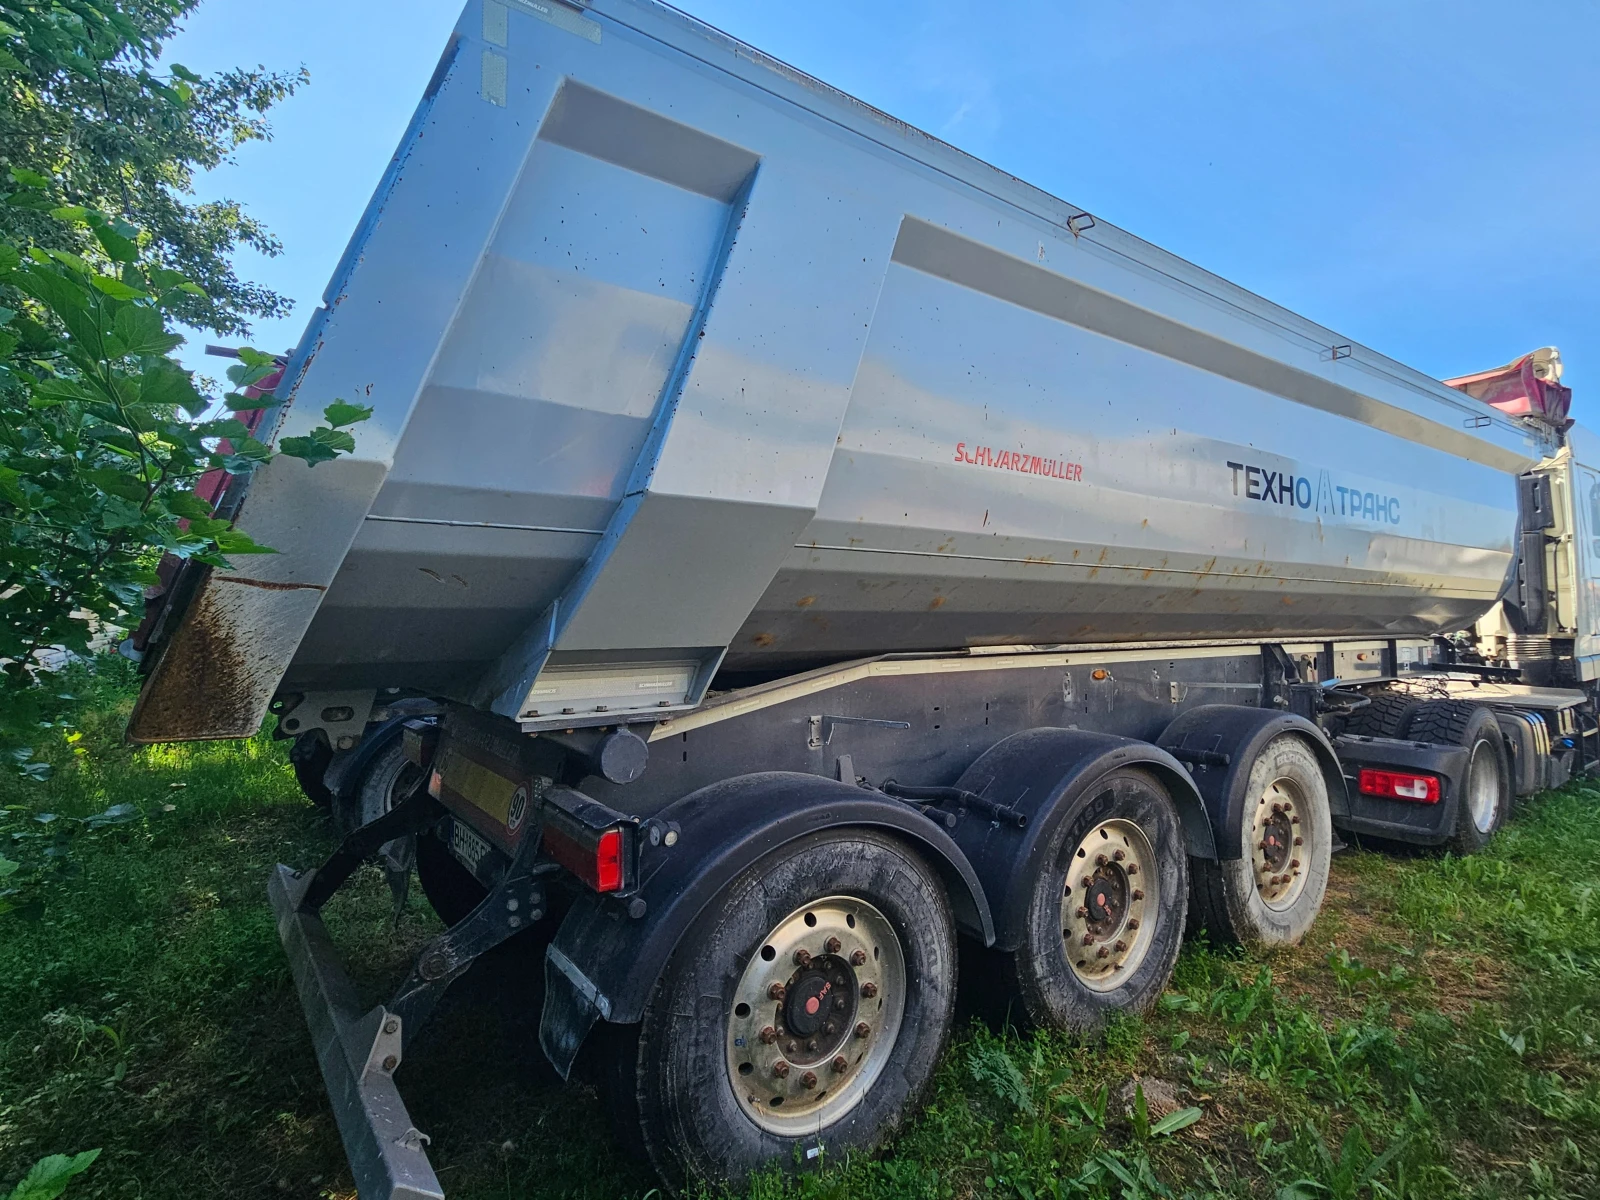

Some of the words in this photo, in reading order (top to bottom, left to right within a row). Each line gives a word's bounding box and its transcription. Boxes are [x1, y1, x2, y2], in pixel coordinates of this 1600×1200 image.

[954, 442, 1083, 482] SCHWARZMÜLLER
[1227, 461, 1312, 509] ТЕХНО
[1336, 486, 1400, 525] ТРАНС
[511, 793, 525, 820] 90
[819, 981, 832, 1001] SAF
